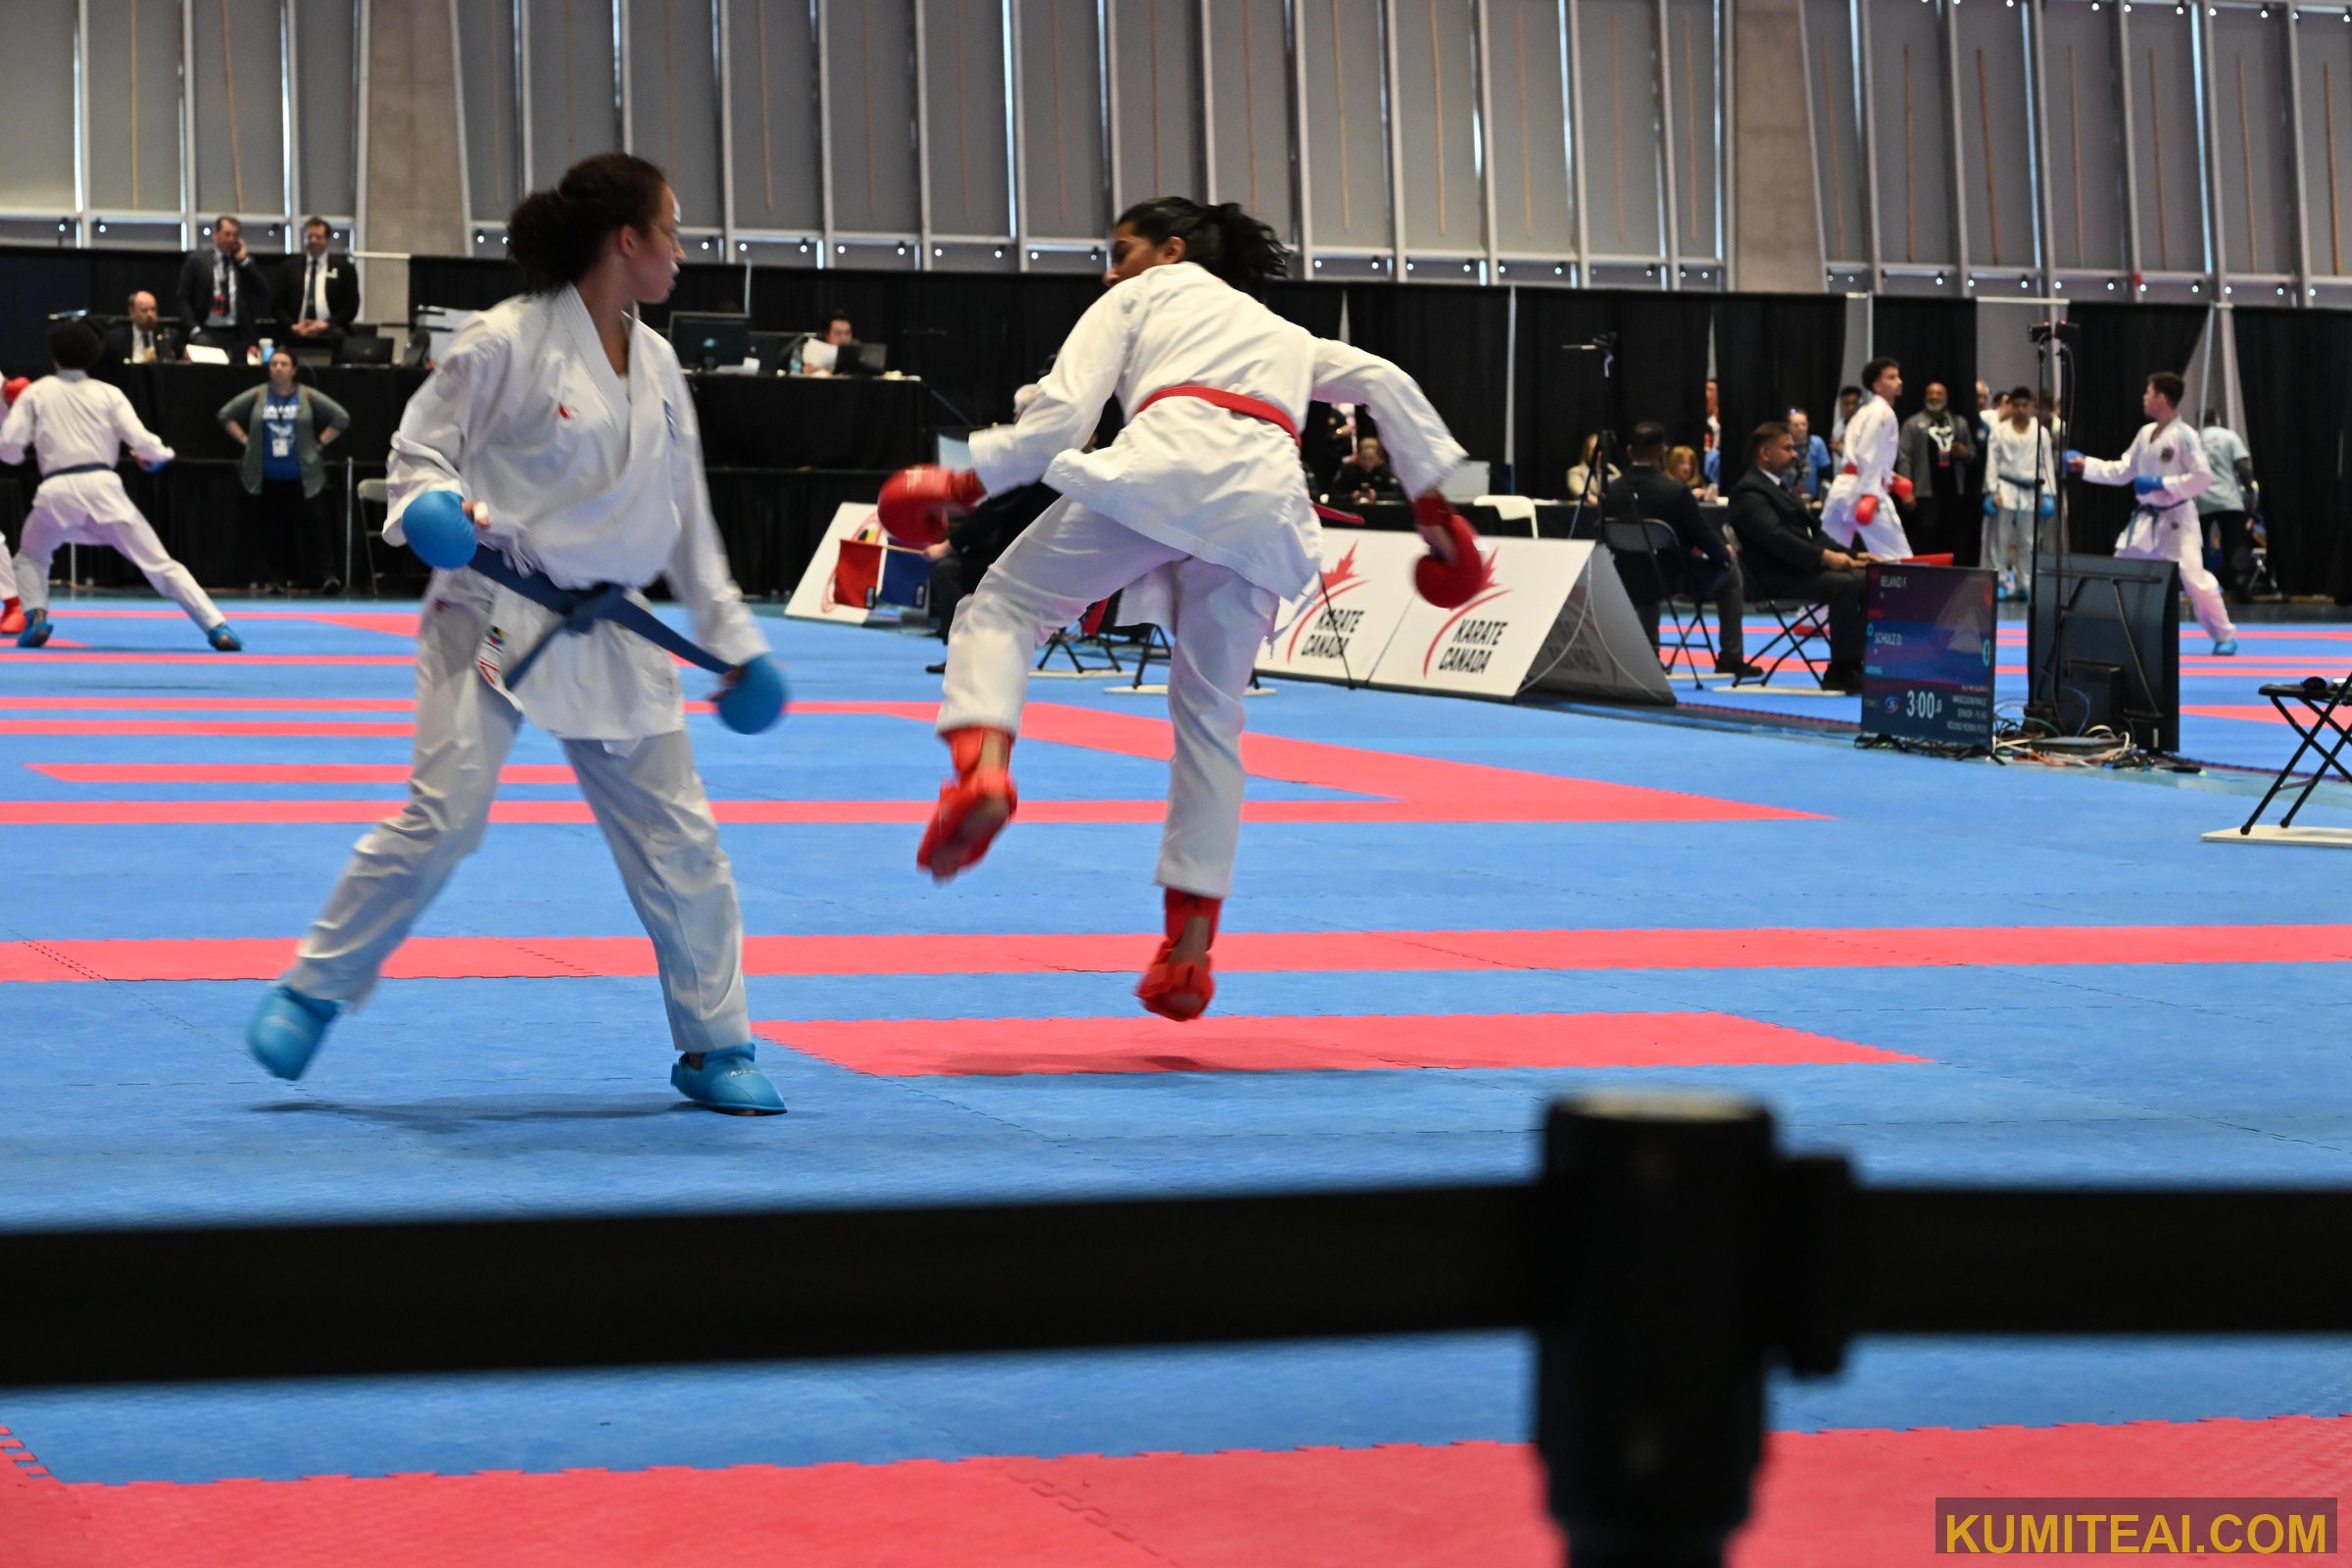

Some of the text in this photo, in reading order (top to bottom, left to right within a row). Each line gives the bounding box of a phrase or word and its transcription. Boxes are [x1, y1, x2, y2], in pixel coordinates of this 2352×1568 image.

[1452, 618, 1508, 646] KARATE
[1301, 634, 1350, 659] CANADA
[1439, 647, 1493, 673] CANADA
